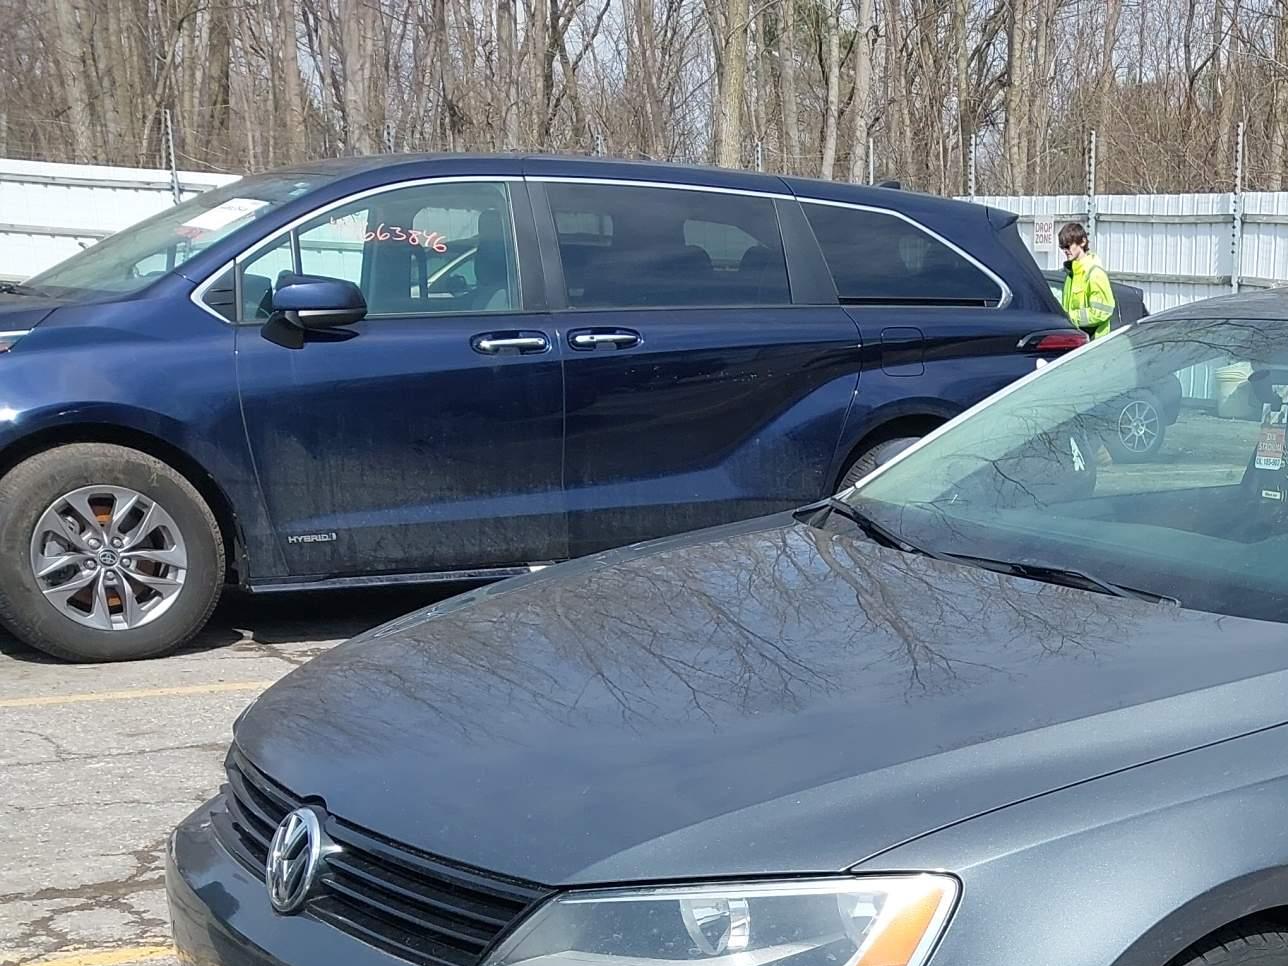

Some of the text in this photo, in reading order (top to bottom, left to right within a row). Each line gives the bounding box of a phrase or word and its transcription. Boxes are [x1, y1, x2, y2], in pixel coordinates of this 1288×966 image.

[1035, 222, 1053, 233] DROP
[1035, 233, 1053, 244] ZONE
[288, 534, 329, 543] HYBRID
